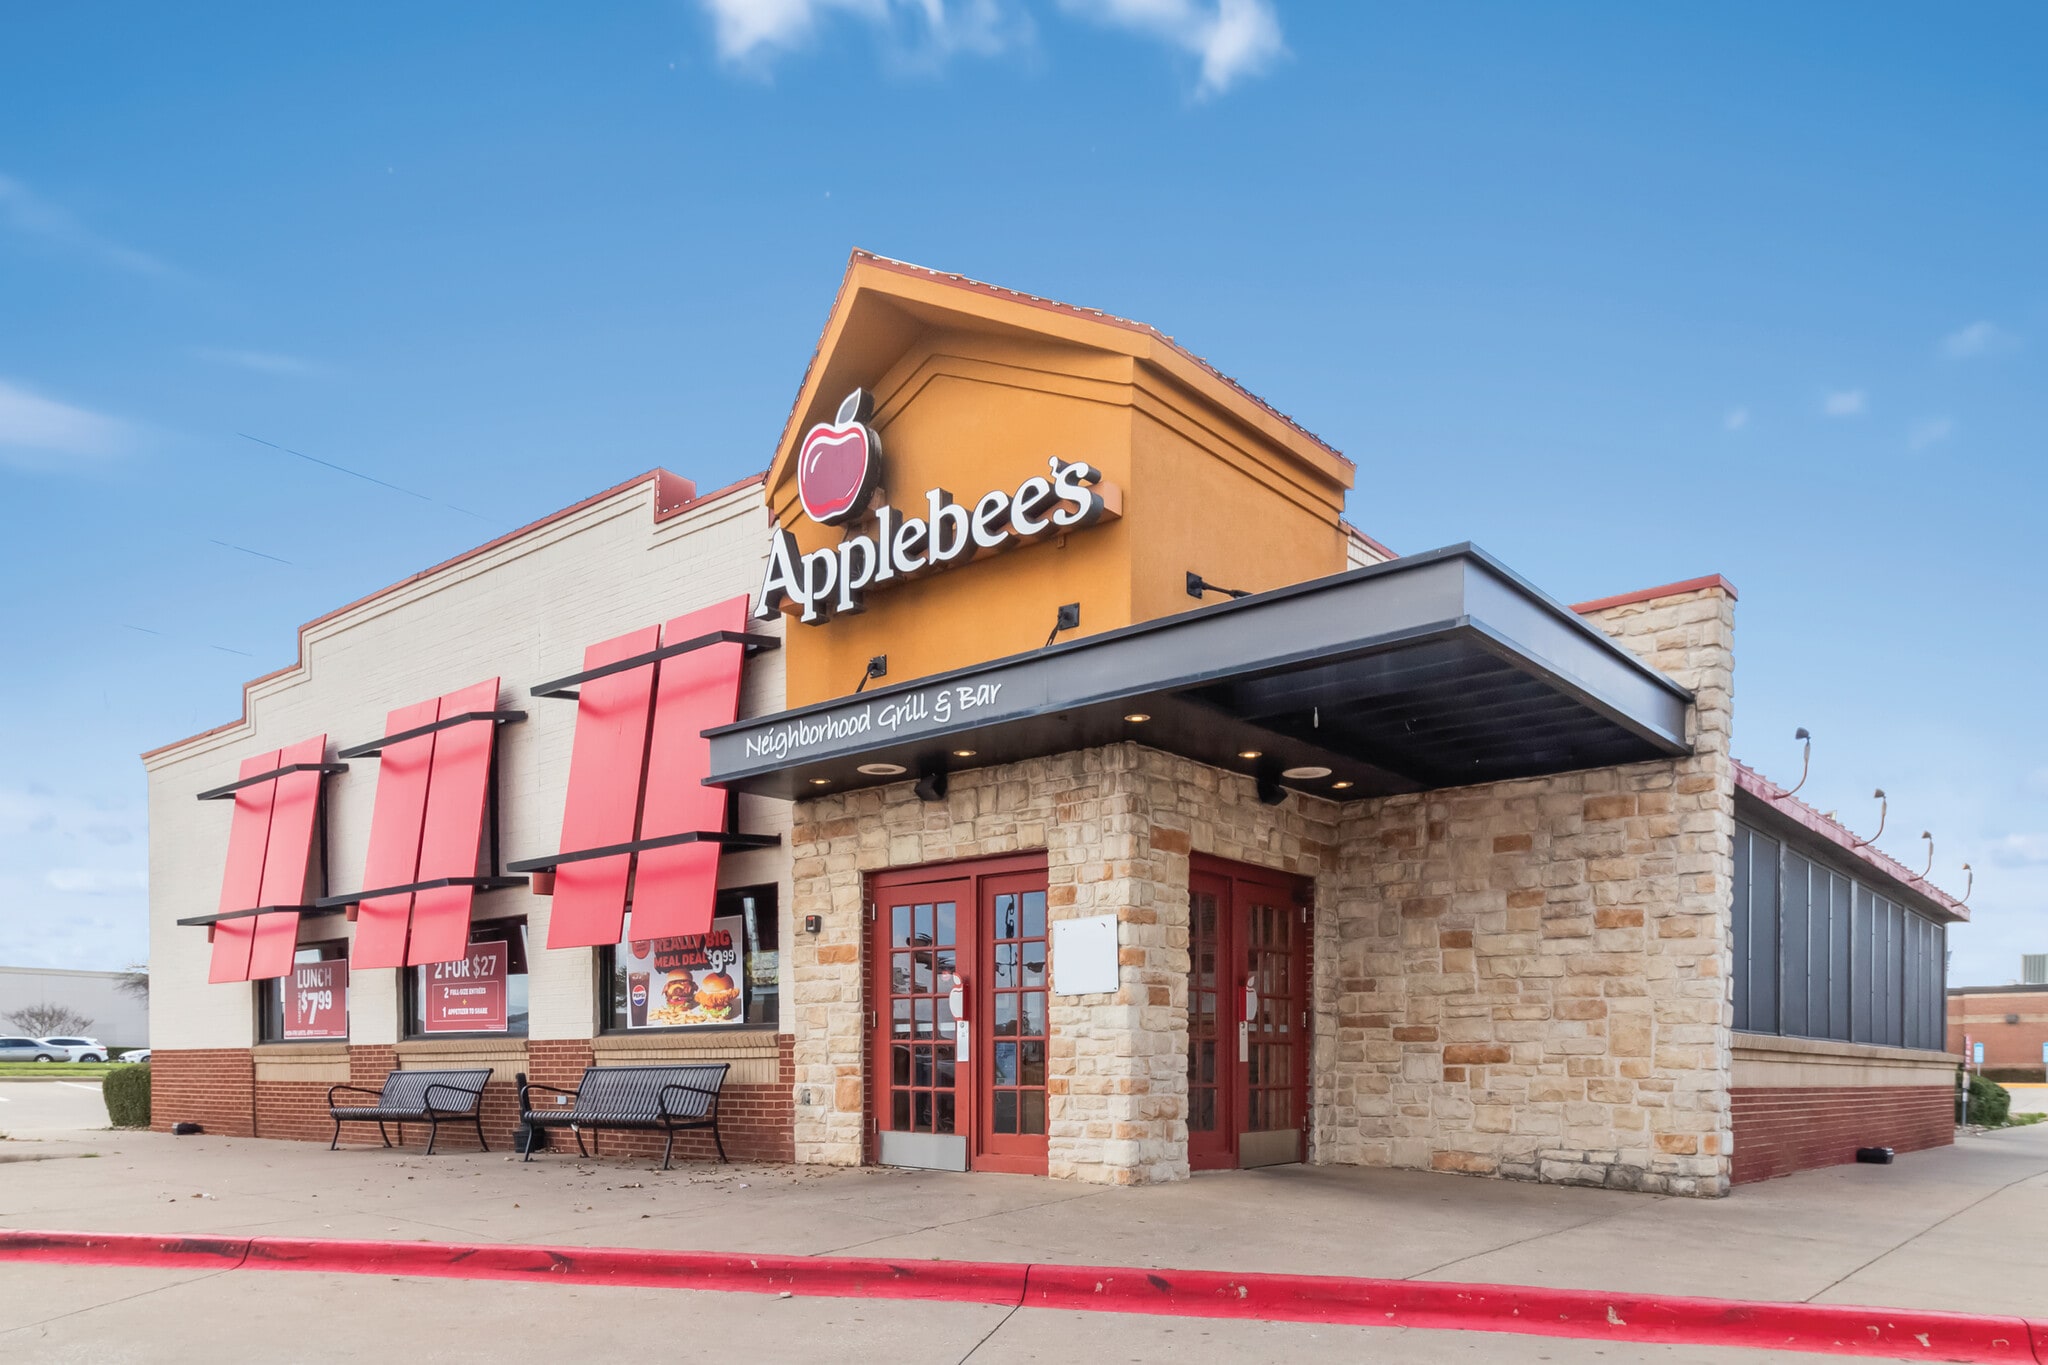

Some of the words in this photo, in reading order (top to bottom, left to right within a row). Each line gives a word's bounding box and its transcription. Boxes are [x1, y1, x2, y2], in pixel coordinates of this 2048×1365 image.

[754, 455, 1096, 624] Applebee's
[746, 705, 871, 758] Neighborhood
[878, 694, 928, 732] Grill
[933, 690, 951, 723] &
[956, 683, 1002, 711] Bar
[654, 934, 704, 952] REALLY
[705, 929, 729, 947] BIG
[434, 963, 442, 979] 2
[445, 958, 470, 978] FOR
[473, 954, 497, 979] $27
[654, 954, 680, 968] MEAL
[682, 951, 708, 965] DEAL
[297, 967, 332, 988] LUNCH
[443, 987, 449, 999] 2
[442, 1006, 447, 1018] 1
